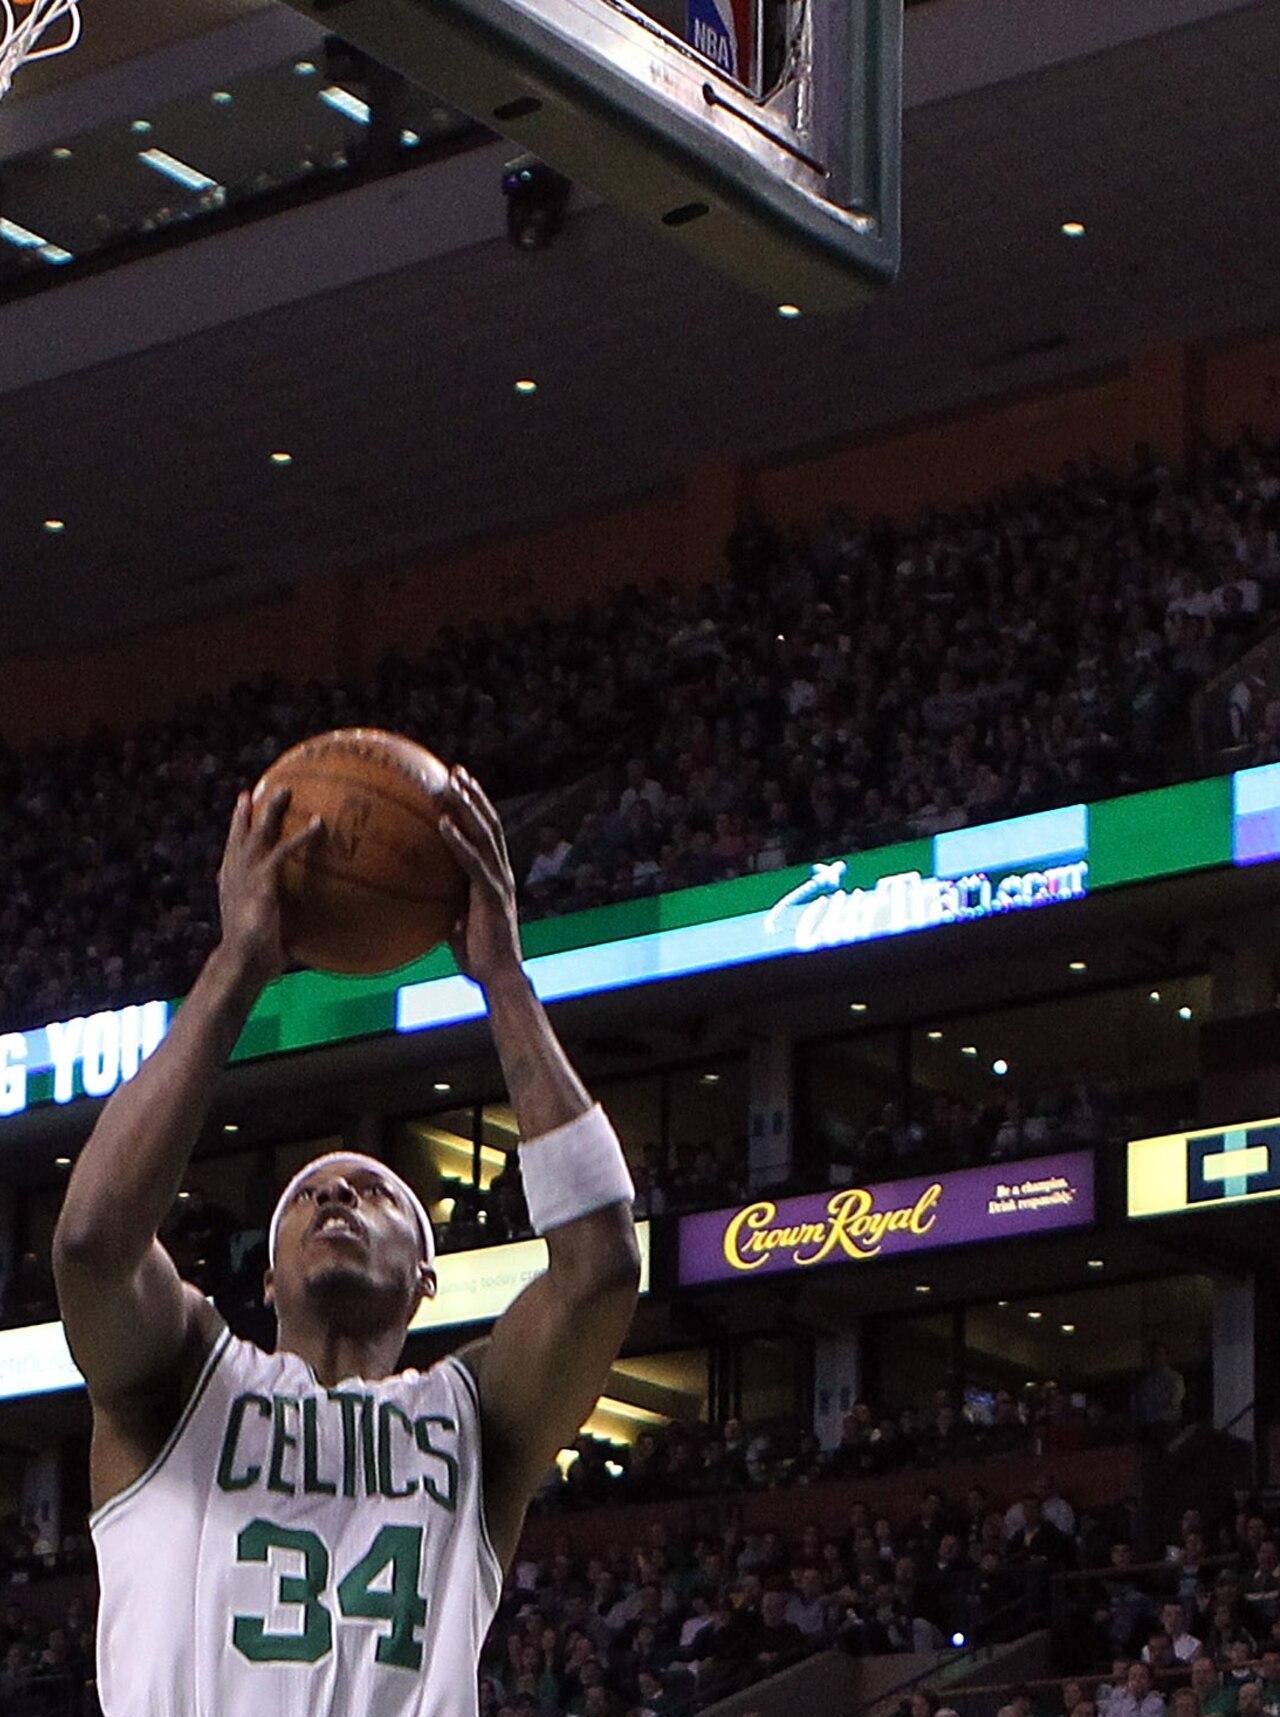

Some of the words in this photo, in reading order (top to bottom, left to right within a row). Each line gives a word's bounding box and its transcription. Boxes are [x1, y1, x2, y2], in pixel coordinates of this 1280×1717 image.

[694, 17, 730, 73] NBA
[46, 1000, 169, 1103] YOU
[723, 1201, 826, 1269] Crown
[792, 1183, 942, 1265] Royal
[217, 1391, 459, 1514] CELTICS
[231, 1517, 428, 1672] 34
